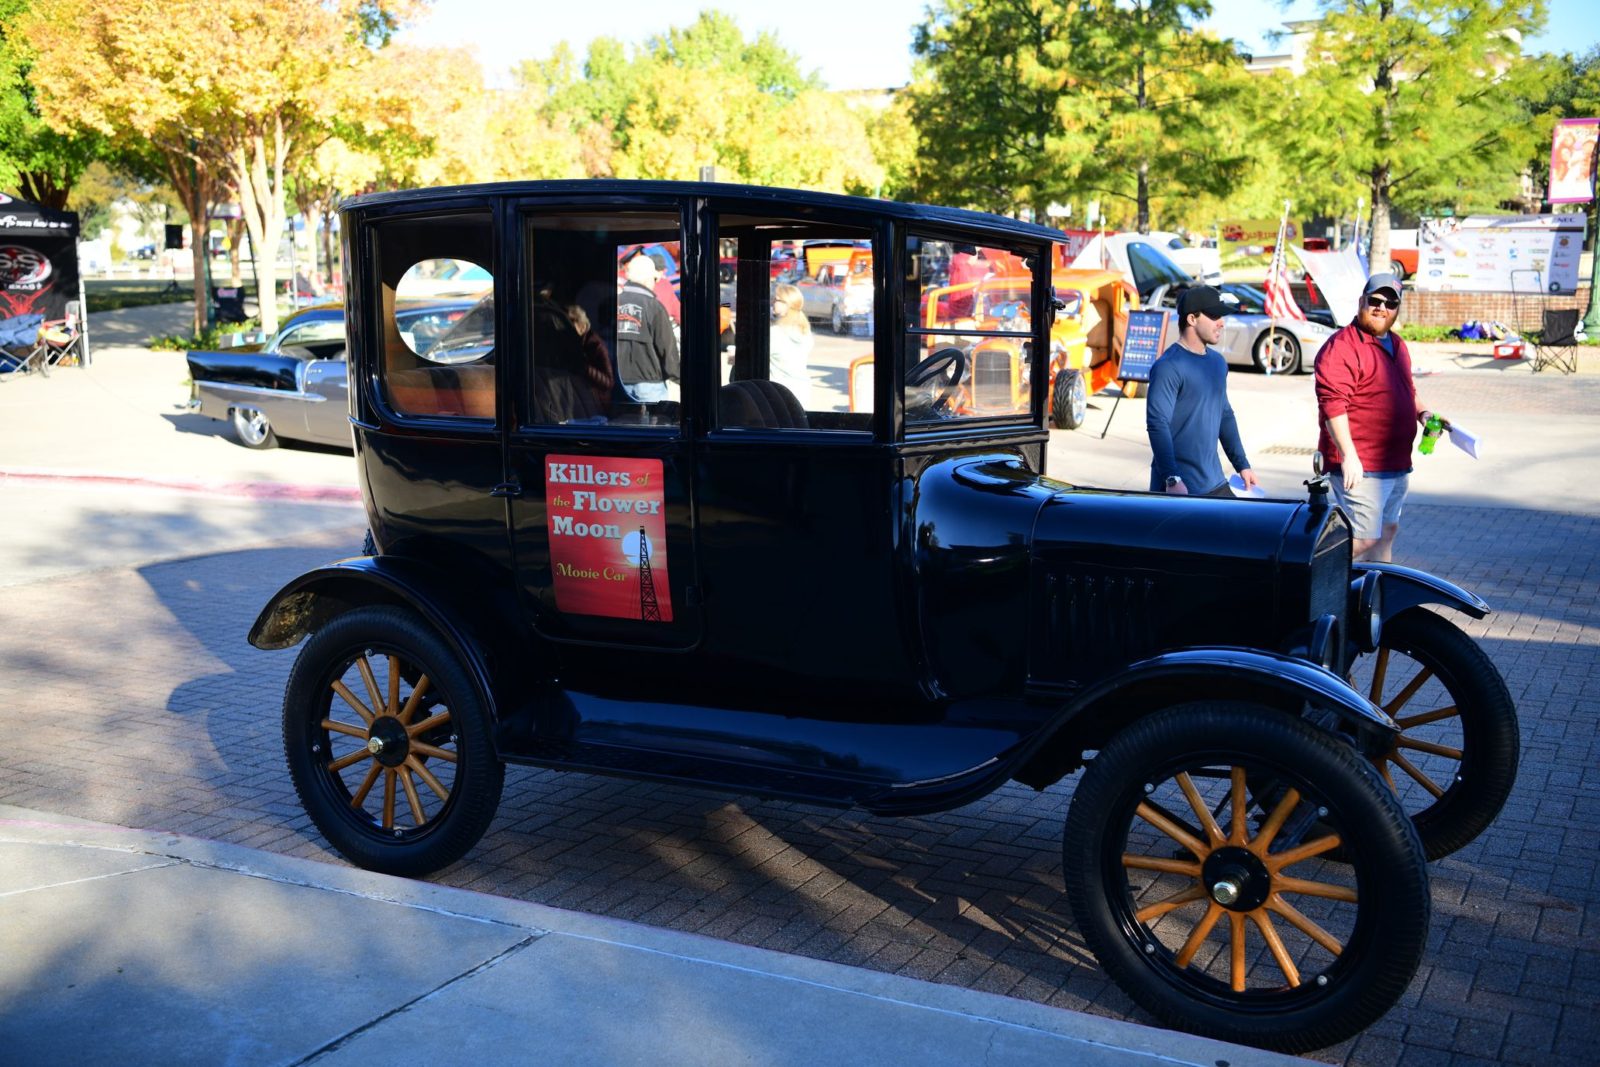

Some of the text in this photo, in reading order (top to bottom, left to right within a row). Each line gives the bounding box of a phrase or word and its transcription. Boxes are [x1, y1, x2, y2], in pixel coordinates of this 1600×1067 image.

[548, 463, 649, 487] Killers of
[553, 491, 661, 515] the Flower
[552, 515, 621, 539] Moon
[556, 562, 628, 581] Movie Car
